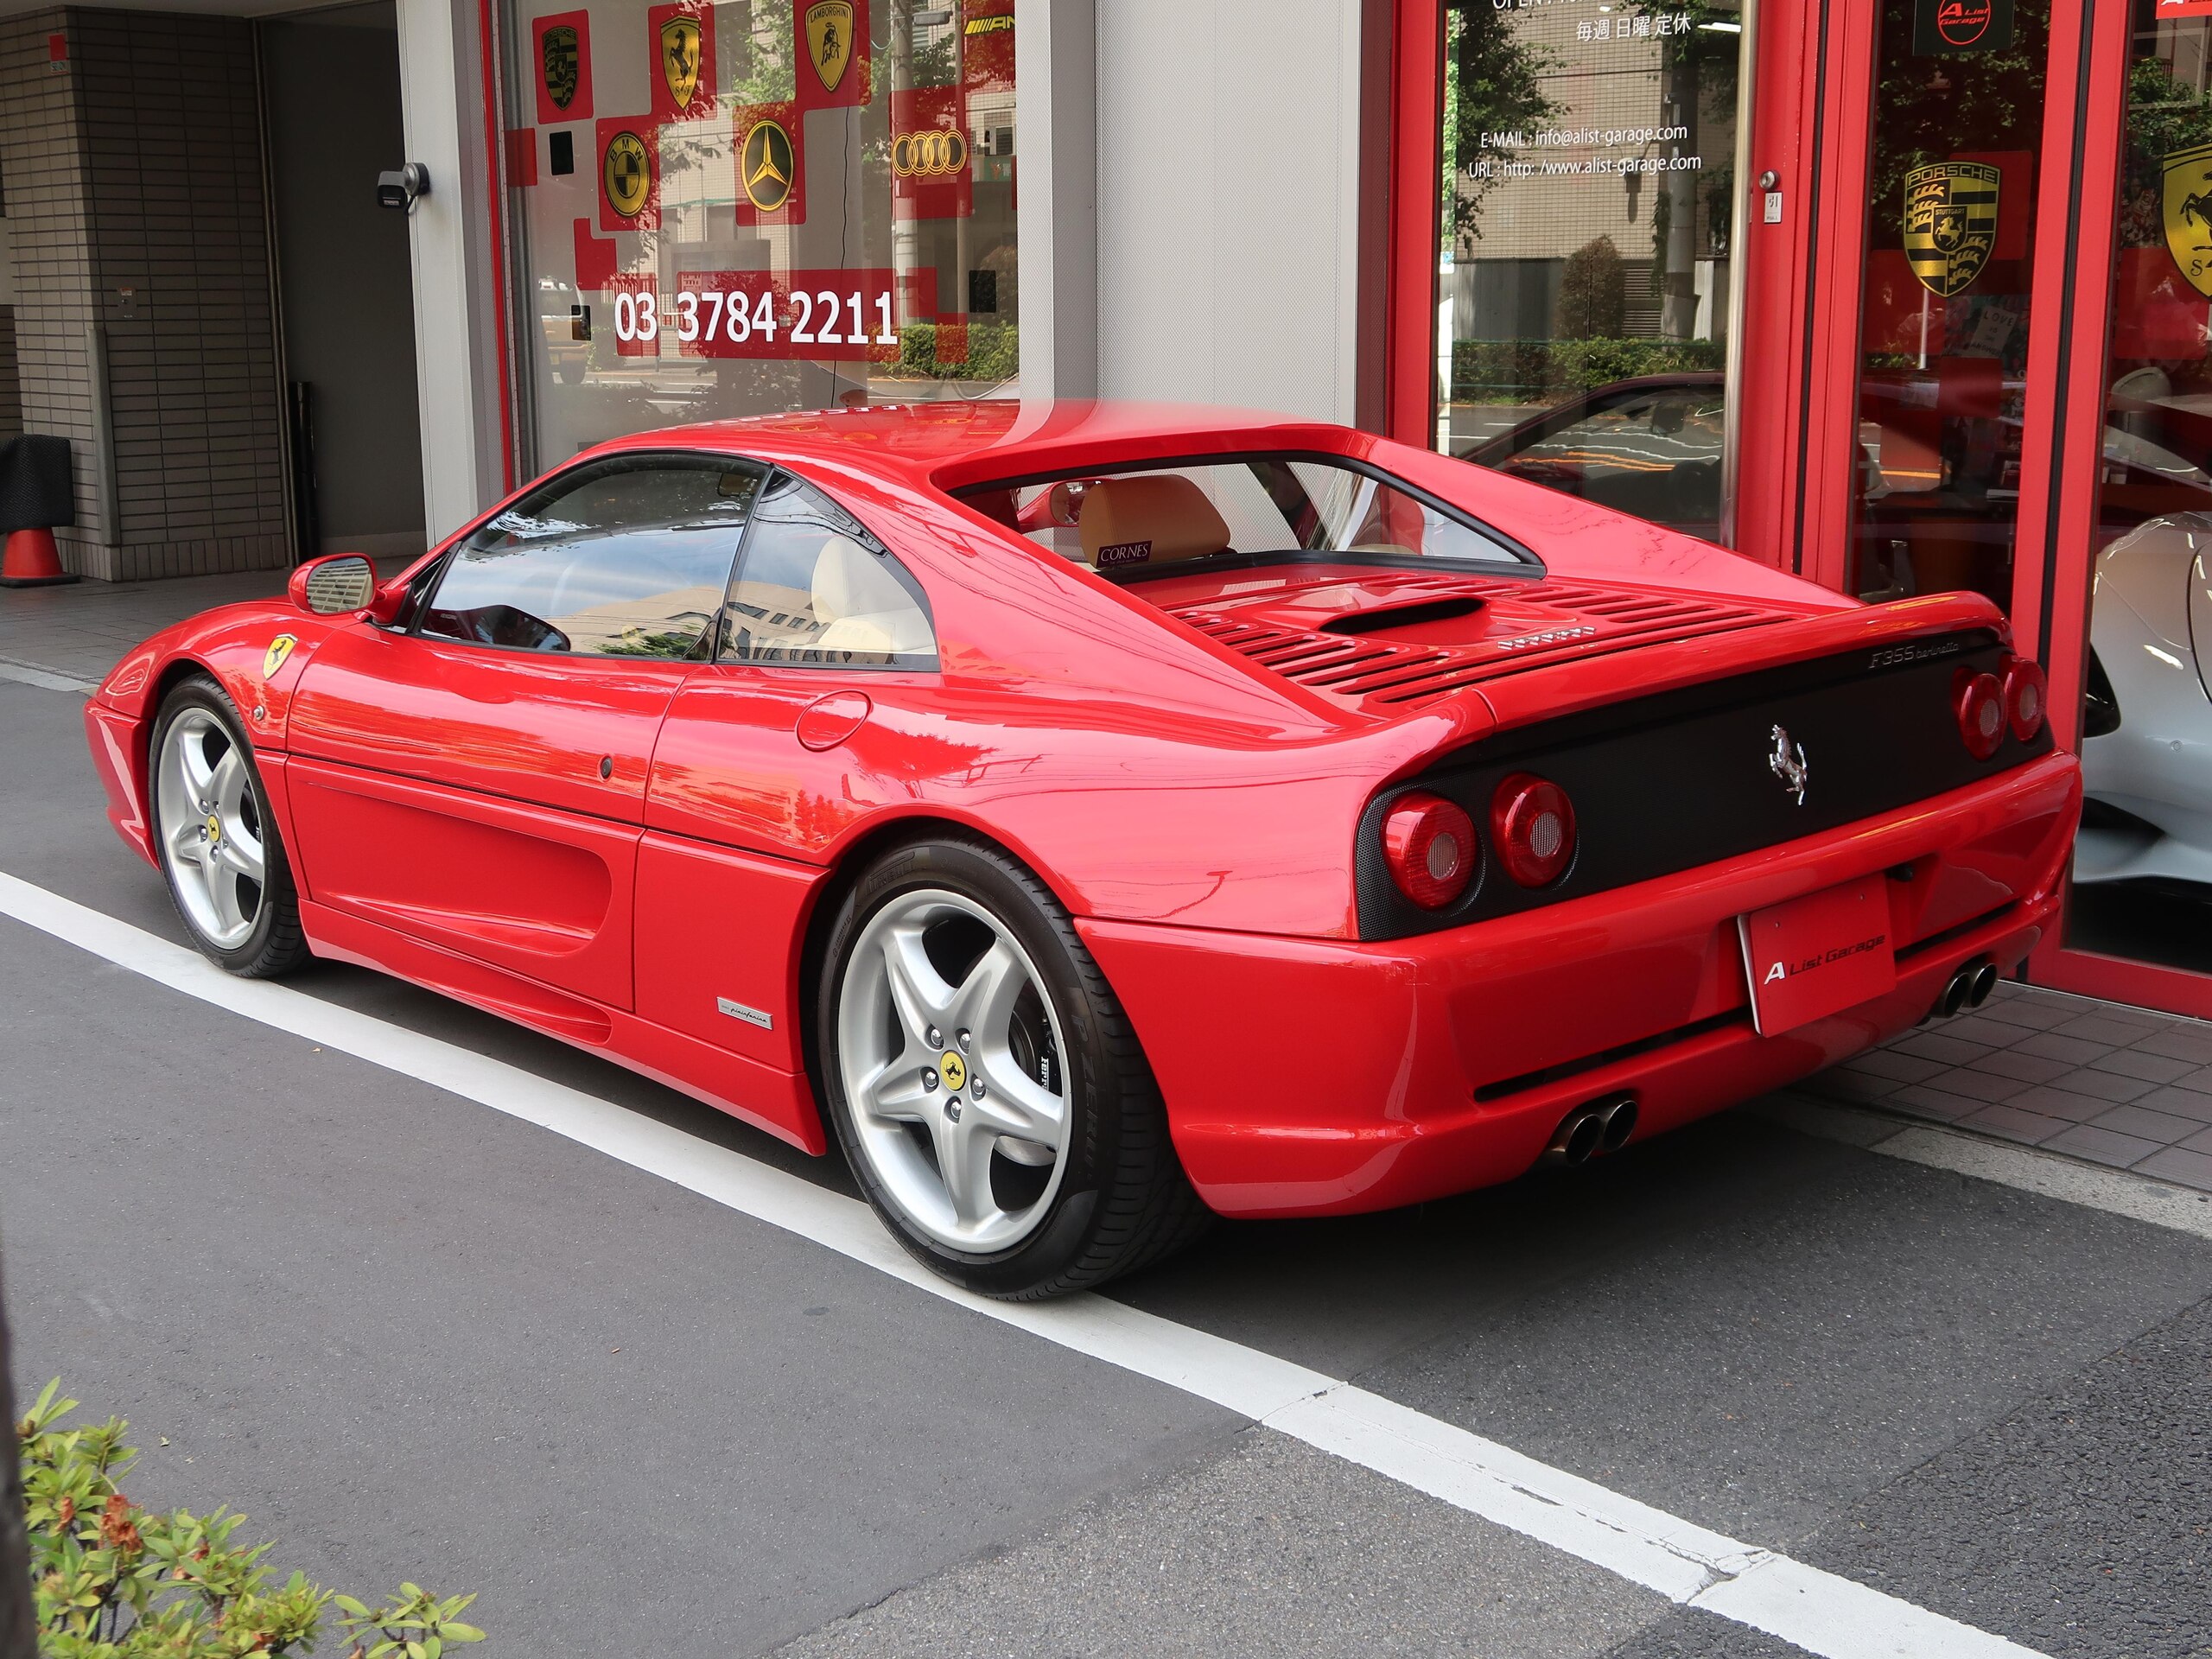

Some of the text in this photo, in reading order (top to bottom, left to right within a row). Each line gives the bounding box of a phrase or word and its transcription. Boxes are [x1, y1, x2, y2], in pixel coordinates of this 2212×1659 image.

[809, 5, 849, 23] LAMBORGHINI
[1939, 3, 1962, 17] A
[1940, 16, 1986, 26] Garage
[1480, 130, 1526, 149] E-MAIL
[1535, 124, 1688, 146] info@alist-garage.com
[1469, 162, 1494, 178] URL
[1908, 165, 1996, 187] PORSCHE
[614, 290, 899, 345] 03 3784 2211
[1983, 311, 2015, 327] LOVE
[1101, 543, 1149, 562] CORNES
[1868, 645, 1916, 669] F355
[1764, 934, 1885, 985] A List Garage
